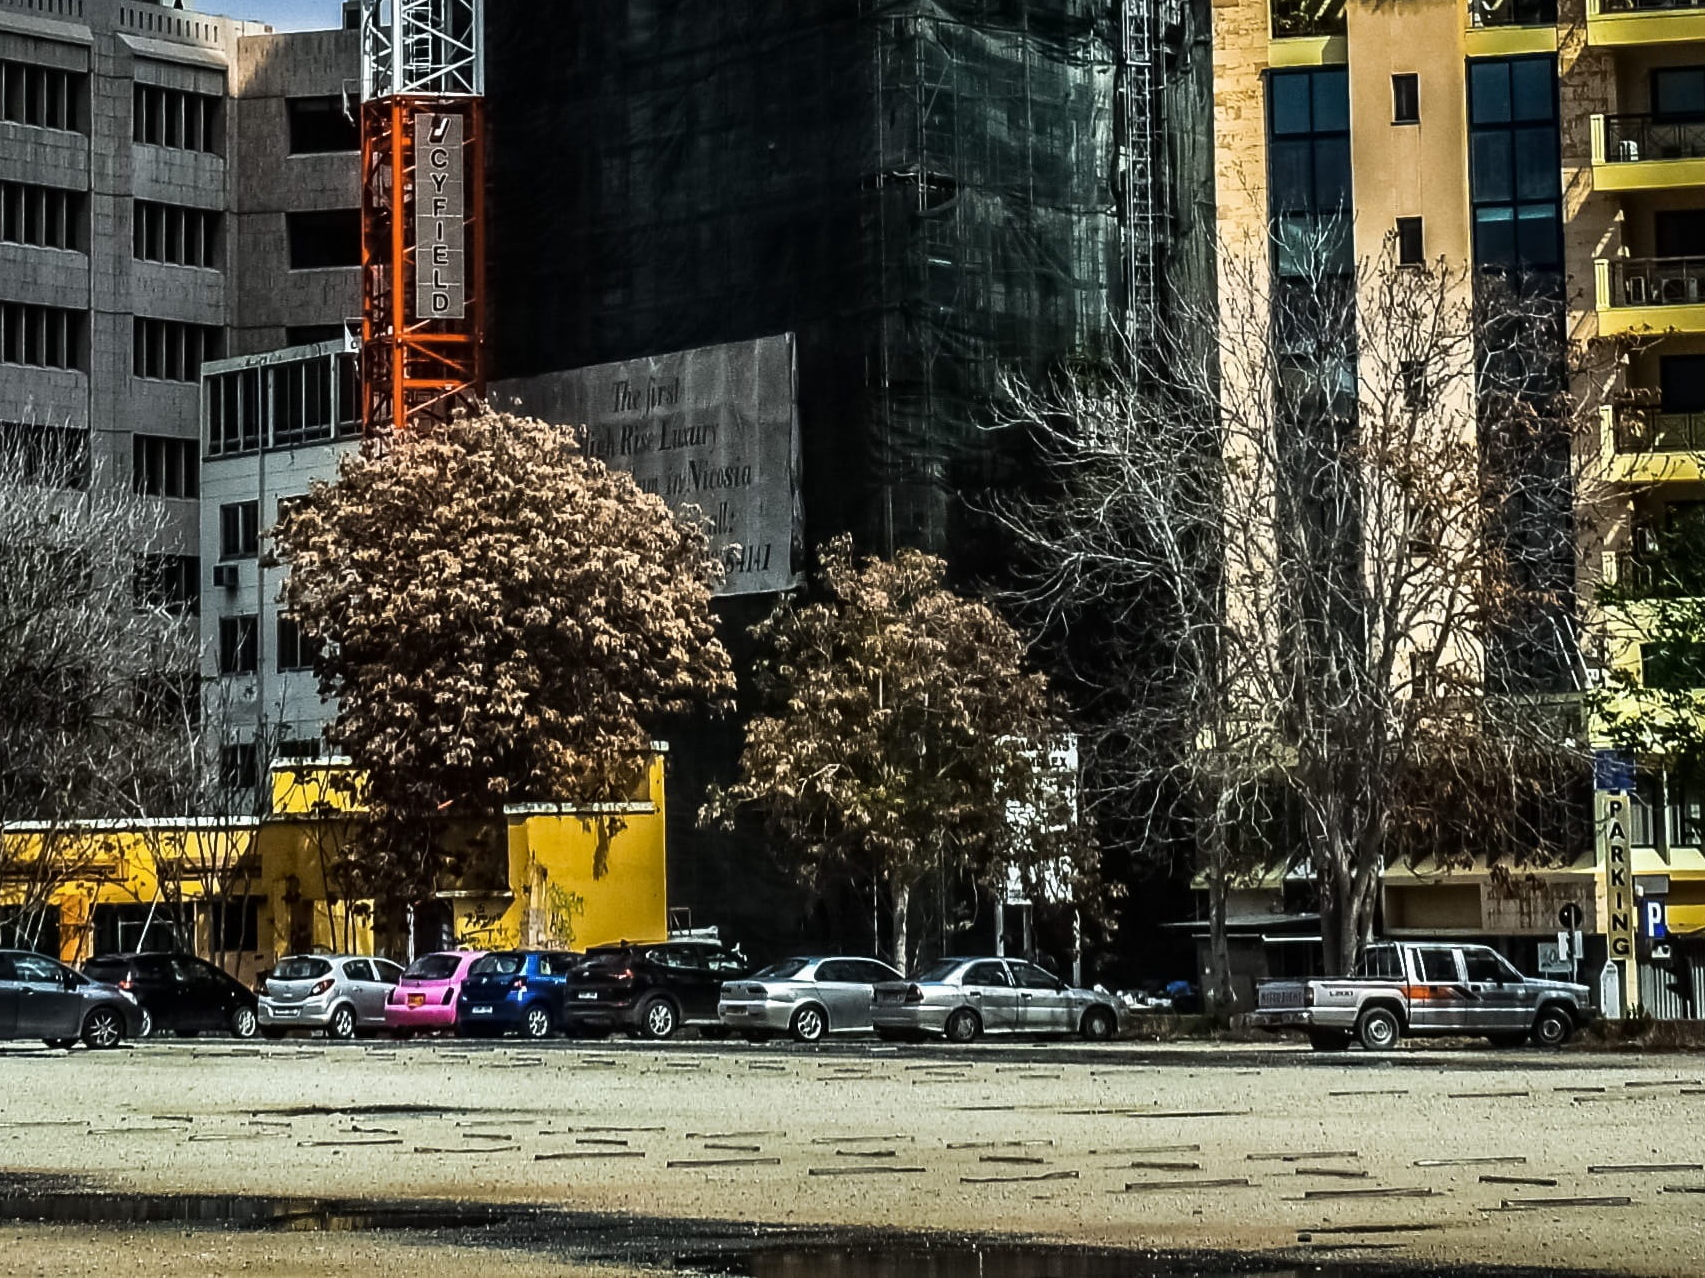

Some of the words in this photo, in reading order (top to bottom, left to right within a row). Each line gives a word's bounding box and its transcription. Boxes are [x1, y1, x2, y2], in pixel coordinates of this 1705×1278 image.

[431, 149, 449, 312] CYFIELD
[613, 381, 641, 412] The
[645, 376, 680, 416] first
[620, 424, 655, 456] Rise
[658, 419, 719, 454] Luxury
[688, 457, 753, 492] Nicosia
[1609, 801, 1630, 956] PARKING
[1648, 901, 1661, 937] P
